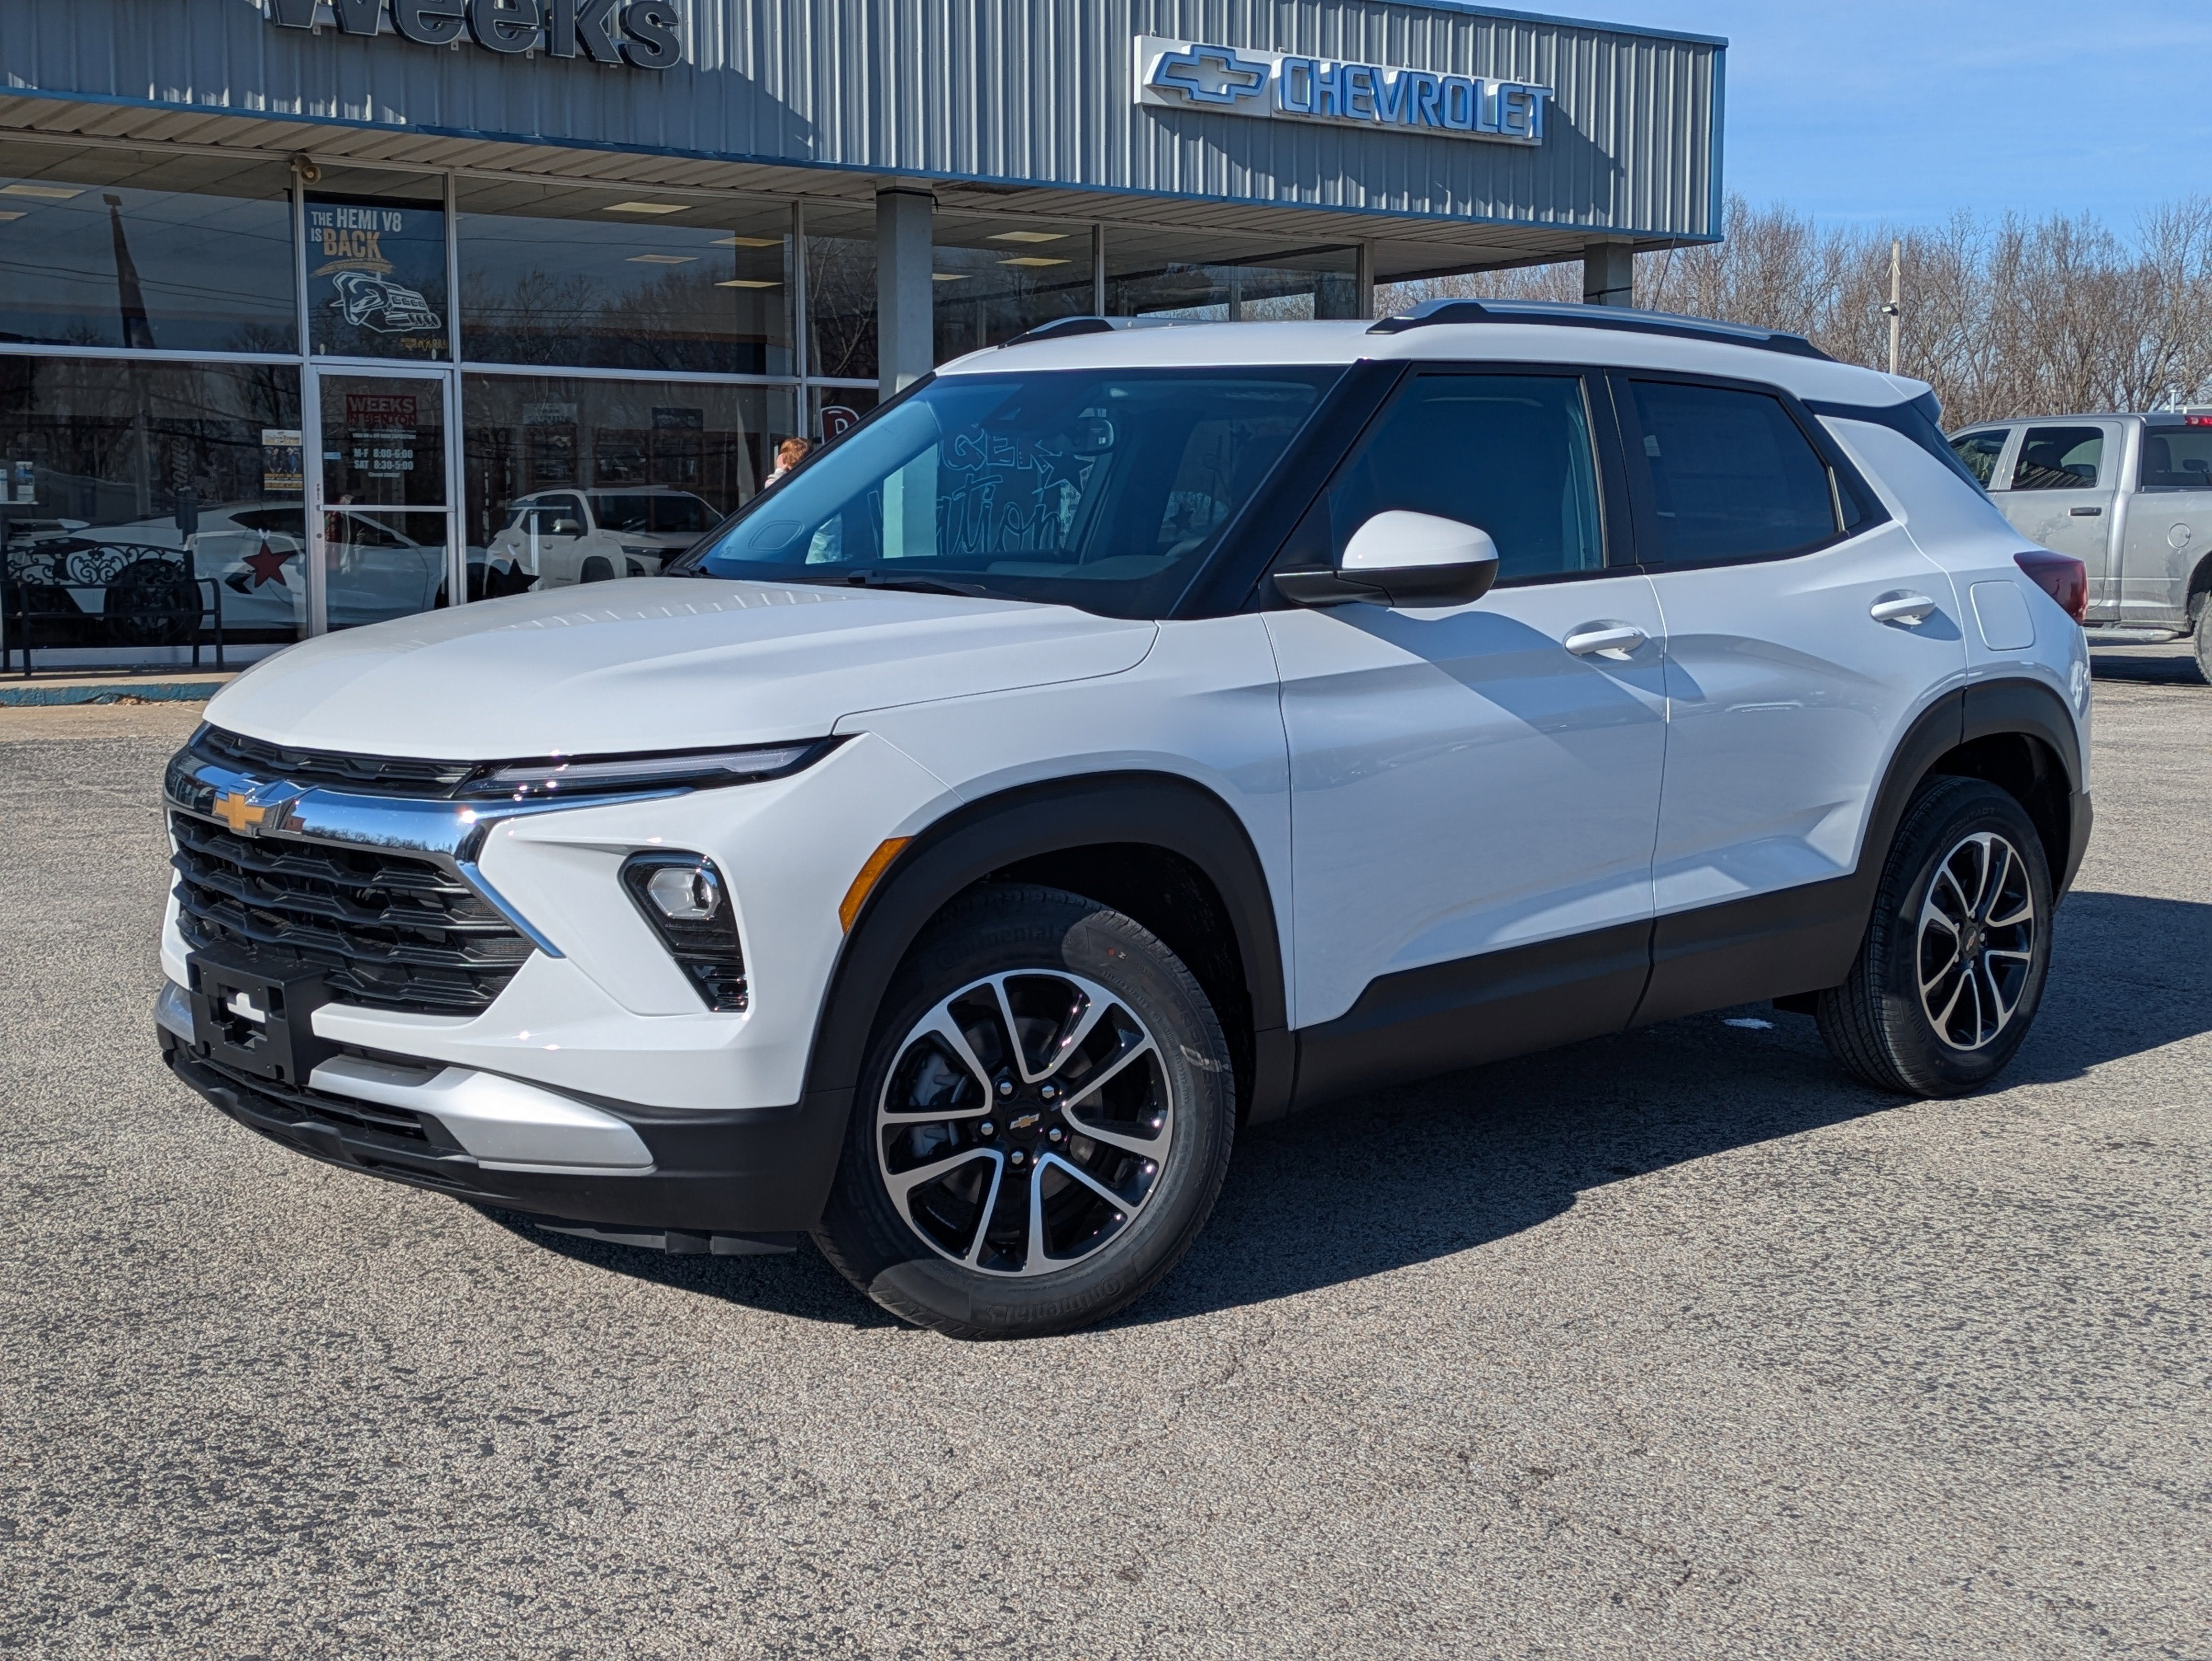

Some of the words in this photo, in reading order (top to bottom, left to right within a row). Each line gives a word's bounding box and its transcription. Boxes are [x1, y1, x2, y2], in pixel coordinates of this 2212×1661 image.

[1273, 56, 1553, 139] CHEVROLET
[310, 211, 333, 226] THE
[337, 208, 377, 230] HEMI
[382, 211, 402, 232] V8
[310, 228, 322, 242] IS
[323, 228, 382, 258] BACK
[348, 397, 414, 413] WEEKS
[354, 448, 369, 458] M-F
[354, 460, 369, 469] SAT
